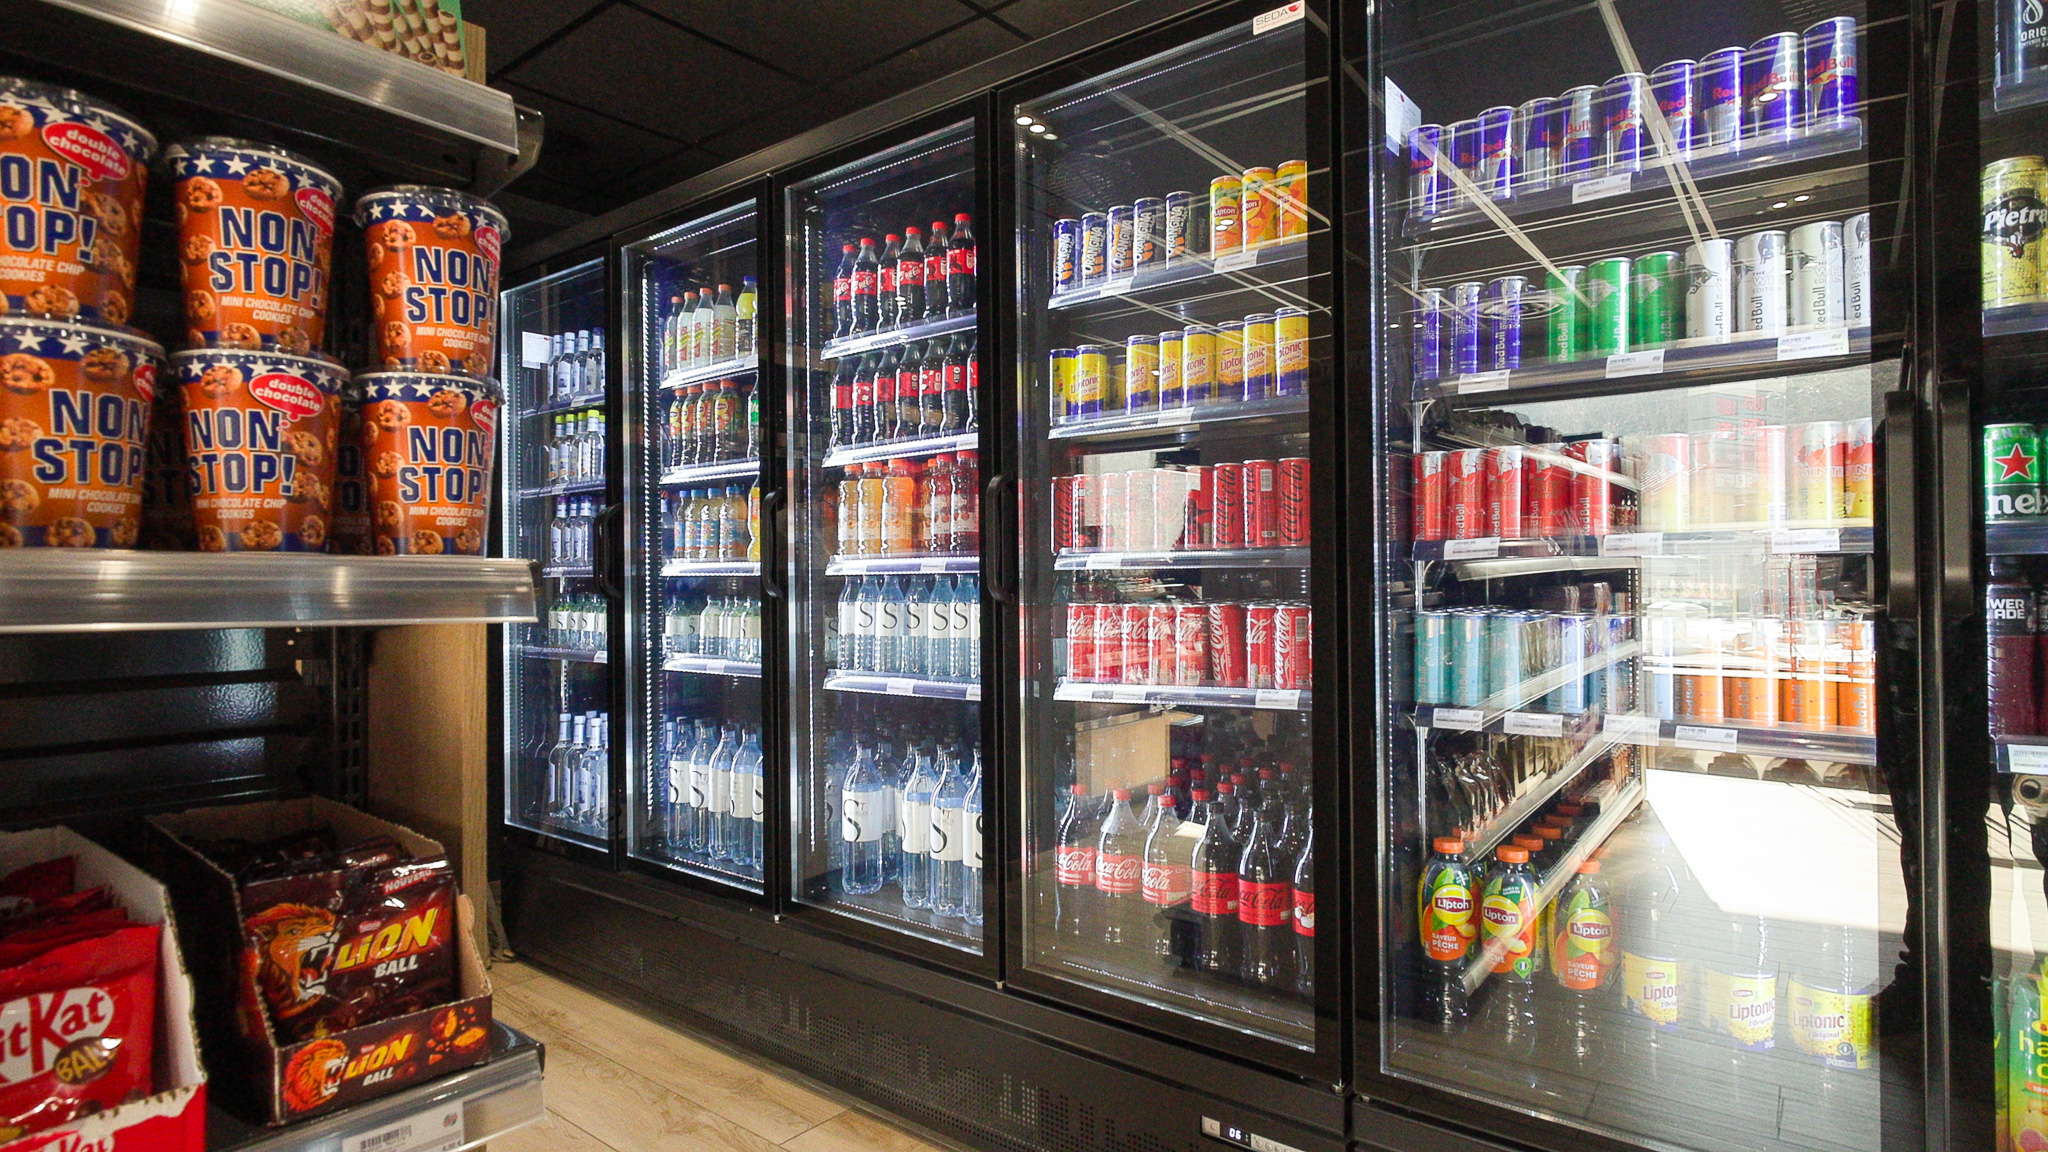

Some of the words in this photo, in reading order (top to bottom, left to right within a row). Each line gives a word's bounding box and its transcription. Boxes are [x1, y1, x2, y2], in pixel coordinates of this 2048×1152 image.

[1255, 8, 1288, 26] SEDA
[1567, 120, 1590, 135] Bull
[49, 136, 126, 175] chocolate
[66, 129, 120, 160] double
[1168, 205, 1185, 257] ORANGINA
[1983, 206, 2048, 232] Pietra
[0, 203, 97, 264] OP!
[218, 205, 318, 265] NON
[1112, 219, 1134, 269] ORANGINA
[1136, 211, 1153, 262] ORANGINA
[1084, 226, 1104, 275] ORANGINA
[57, 261, 86, 275] CHIP
[207, 249, 322, 309] STOP!
[412, 245, 492, 295] NON
[220, 295, 244, 307] MINI
[245, 296, 298, 316] CHOCOLATE
[298, 306, 316, 320] CHIP
[252, 309, 292, 324] COOKIES
[405, 284, 496, 335] STOP!
[415, 325, 436, 337] MINI
[436, 326, 479, 341] CHOCOLATE
[442, 338, 475, 351] COOKIES
[254, 387, 321, 411] chocolate
[268, 378, 316, 399] double
[48, 388, 148, 445] NON
[188, 406, 283, 452] NON
[407, 425, 486, 468] NON
[188, 450, 297, 496] STOP!
[48, 487, 77, 500] MINI
[263, 499, 288, 509] CHIP
[87, 501, 127, 515] COOKIES
[217, 508, 255, 519] COOKIES
[408, 505, 430, 517] MINI
[429, 506, 473, 518] CHOCOLATE
[1456, 503, 1466, 521] Bull
[435, 516, 469, 527] COOKIES
[858, 601, 874, 628] S
[882, 601, 898, 630] S
[906, 601, 921, 630] S
[933, 603, 949, 631] S
[953, 601, 969, 631] S
[843, 798, 862, 842] S
[1437, 899, 1470, 910] Lipton
[1484, 908, 1516, 923] Lipton
[1431, 932, 1457, 942] SAVEUR
[1573, 924, 1609, 937] Lipton
[1432, 939, 1459, 950] PÊCHE
[374, 954, 419, 979] BALL
[1729, 997, 1775, 1021] Liptonic
[1793, 1010, 1845, 1029] Liptonic
[362, 1066, 394, 1087] BALL
[1228, 1127, 1242, 1140] 06
